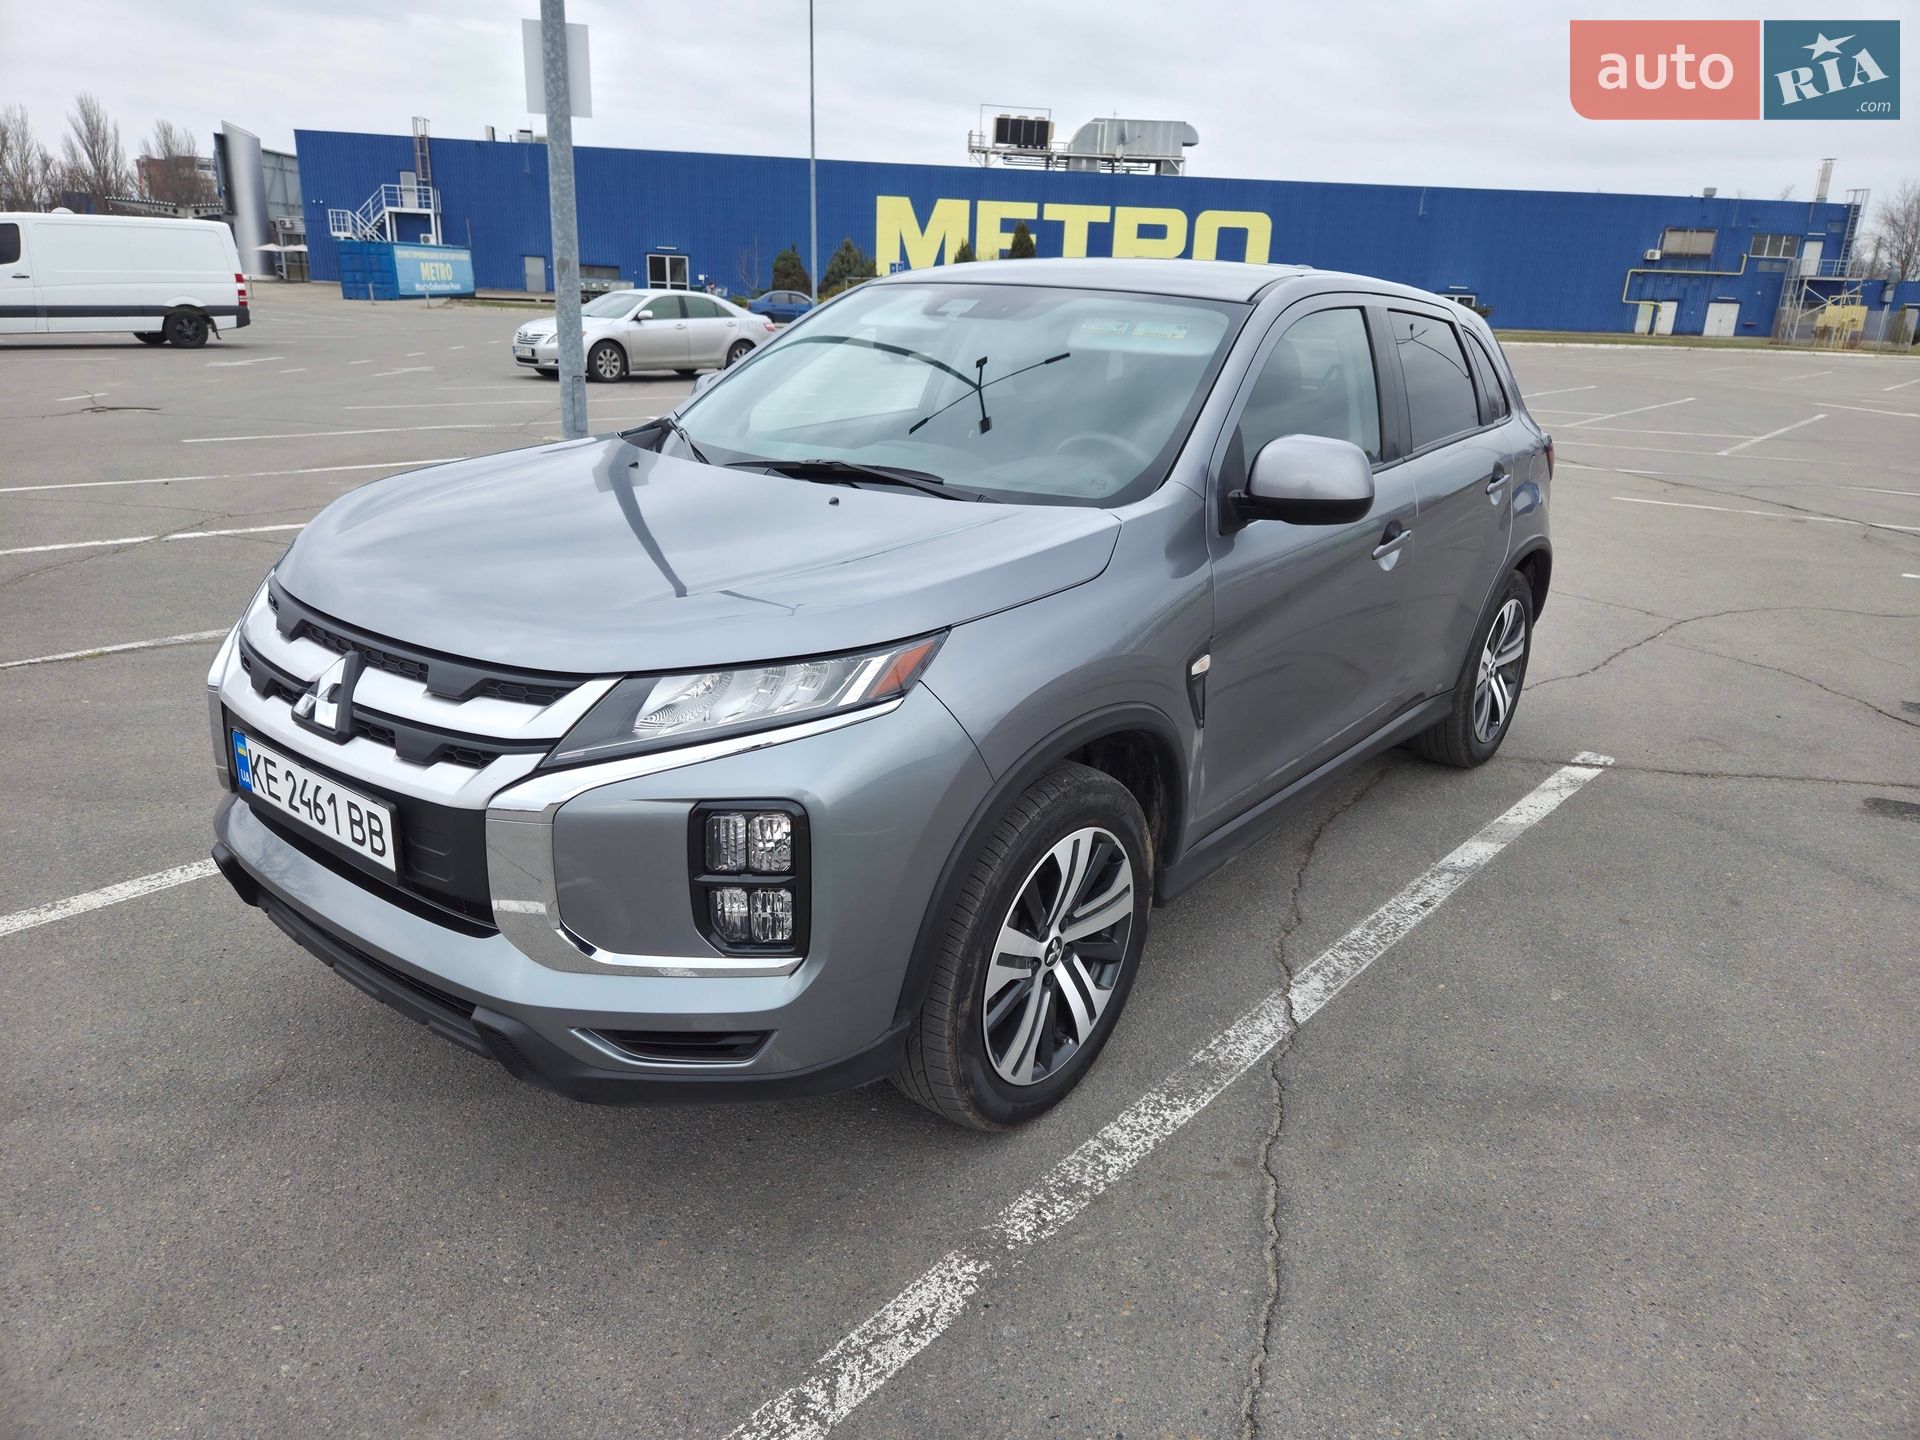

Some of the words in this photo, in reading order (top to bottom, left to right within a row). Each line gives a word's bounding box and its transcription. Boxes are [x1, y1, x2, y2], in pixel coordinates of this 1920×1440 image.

[420, 262, 453, 281] METRO
[240, 769, 251, 785] UA
[248, 749, 282, 803] KE
[285, 770, 341, 836] 2461
[346, 800, 386, 858] BB
